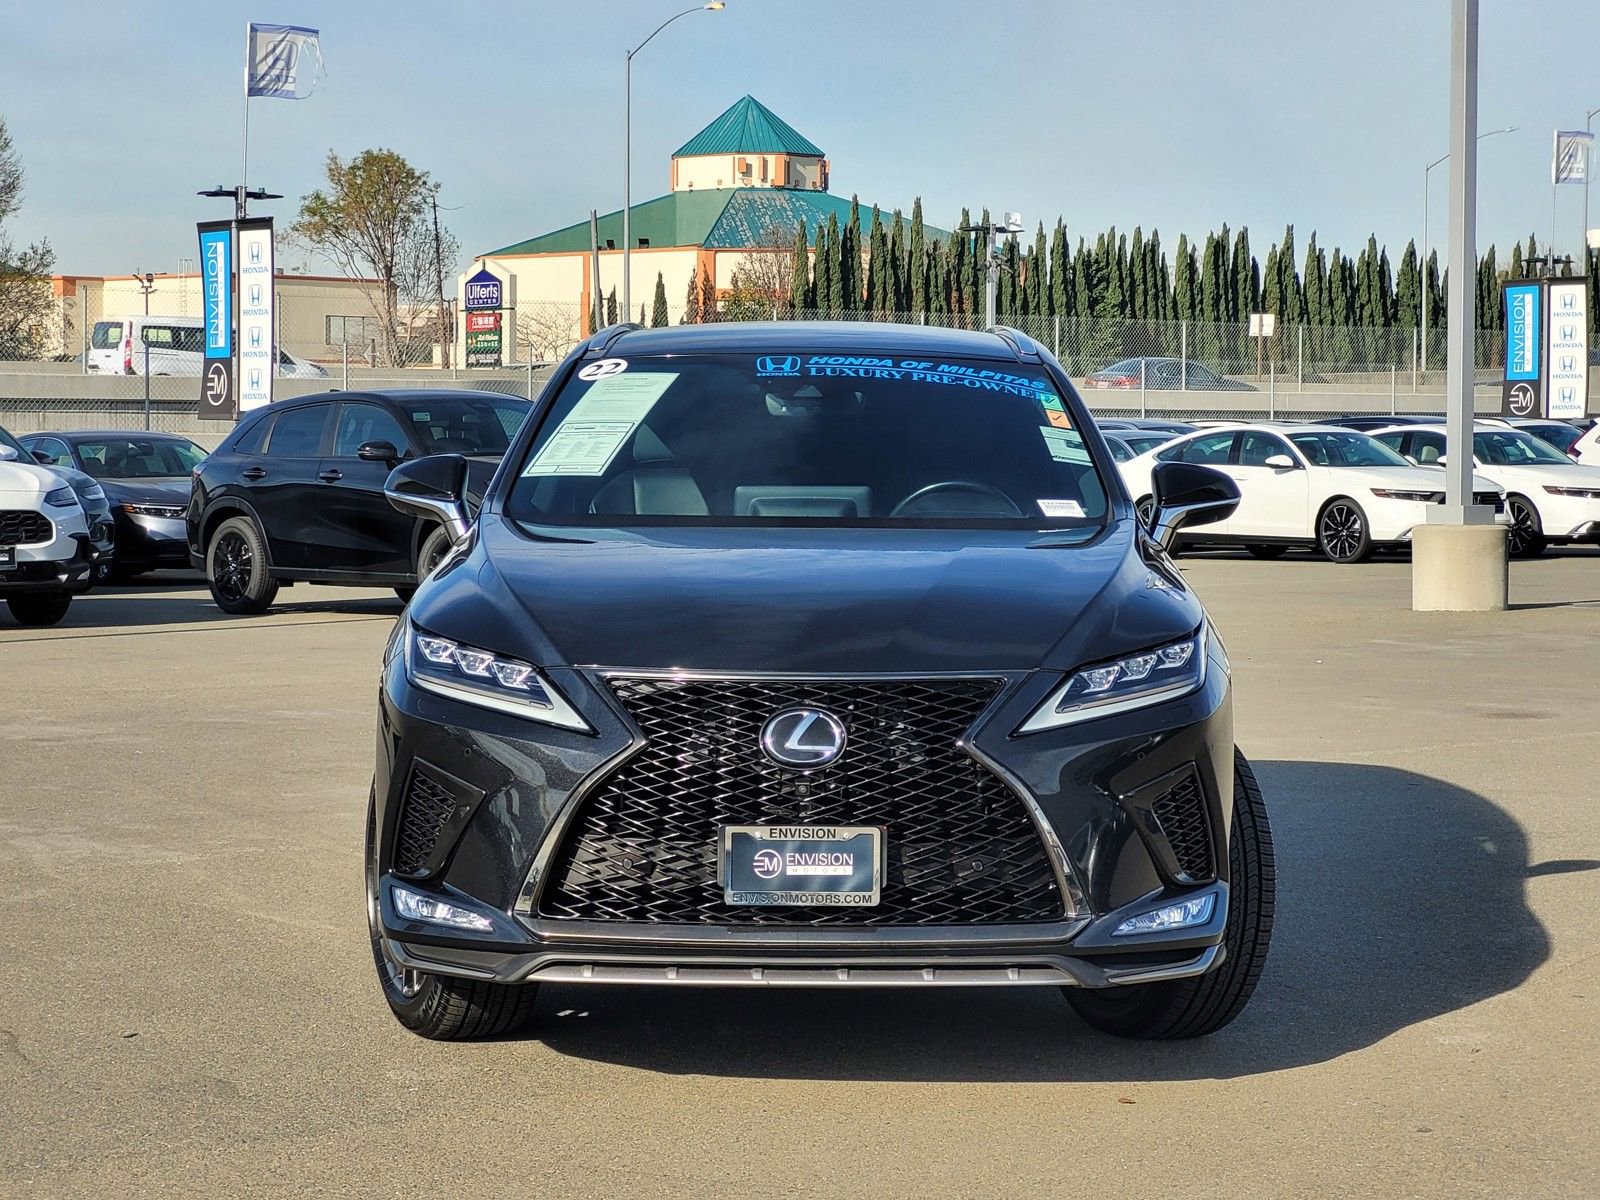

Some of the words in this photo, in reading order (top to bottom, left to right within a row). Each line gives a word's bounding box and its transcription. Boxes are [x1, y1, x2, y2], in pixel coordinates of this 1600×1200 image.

[207, 242, 219, 348] ENVISION
[468, 285, 498, 298] Ulferts
[1513, 293, 1524, 373] ENVISION
[583, 362, 622, 378] 22
[809, 356, 893, 367] HONDA
[900, 360, 934, 369] OF
[937, 364, 1046, 389] MILPITAS
[809, 367, 906, 380] LUXURY
[242, 392, 268, 400] HONDA
[769, 828, 837, 839] ENVISION
[786, 853, 854, 865] ENVISION
[732, 892, 872, 904] ENVISIONMOTORS.COM
